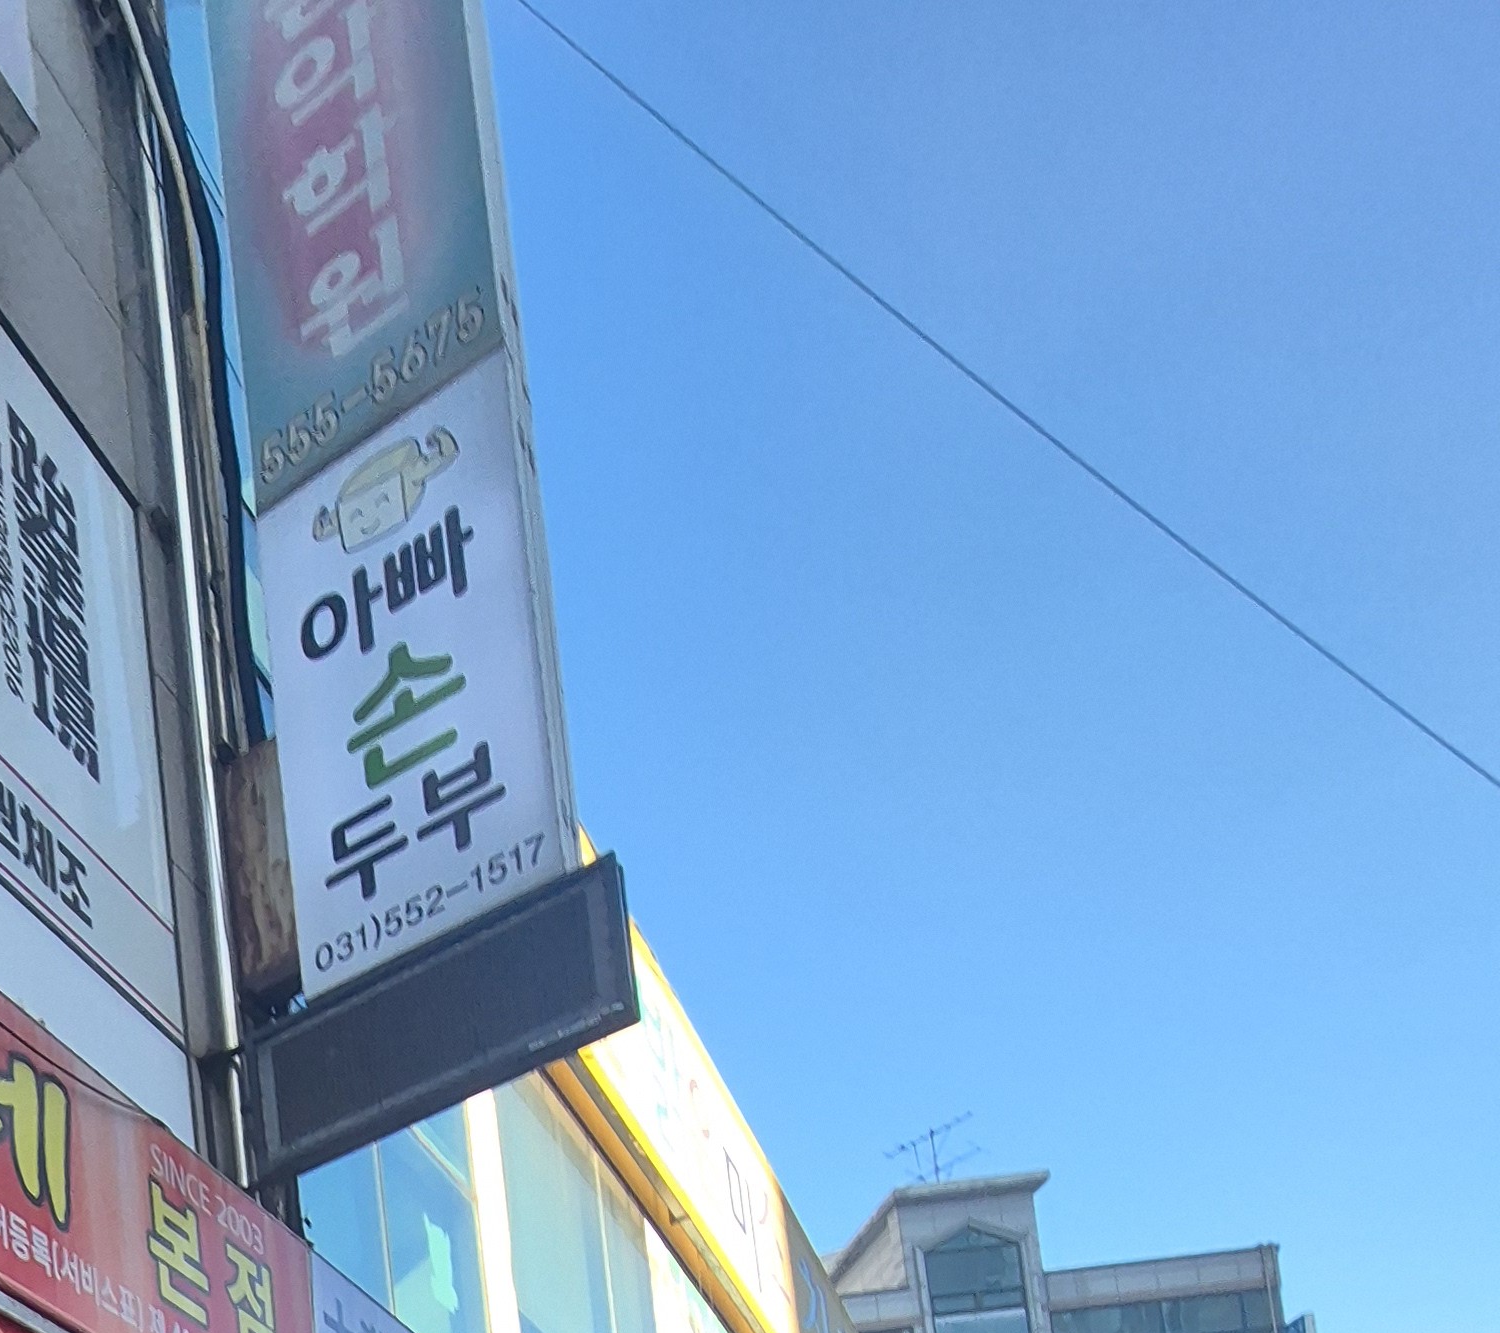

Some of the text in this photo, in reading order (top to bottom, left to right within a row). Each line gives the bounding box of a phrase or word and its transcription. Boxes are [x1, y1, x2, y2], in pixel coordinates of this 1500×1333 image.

[264, 0, 409, 358] 악학원
[301, 505, 475, 661] 아빠
[347, 641, 467, 790] 손
[325, 740, 506, 900] 두부
[315, 832, 546, 974] 031)552-1517
[149, 1143, 265, 1255] SINCE 2003
